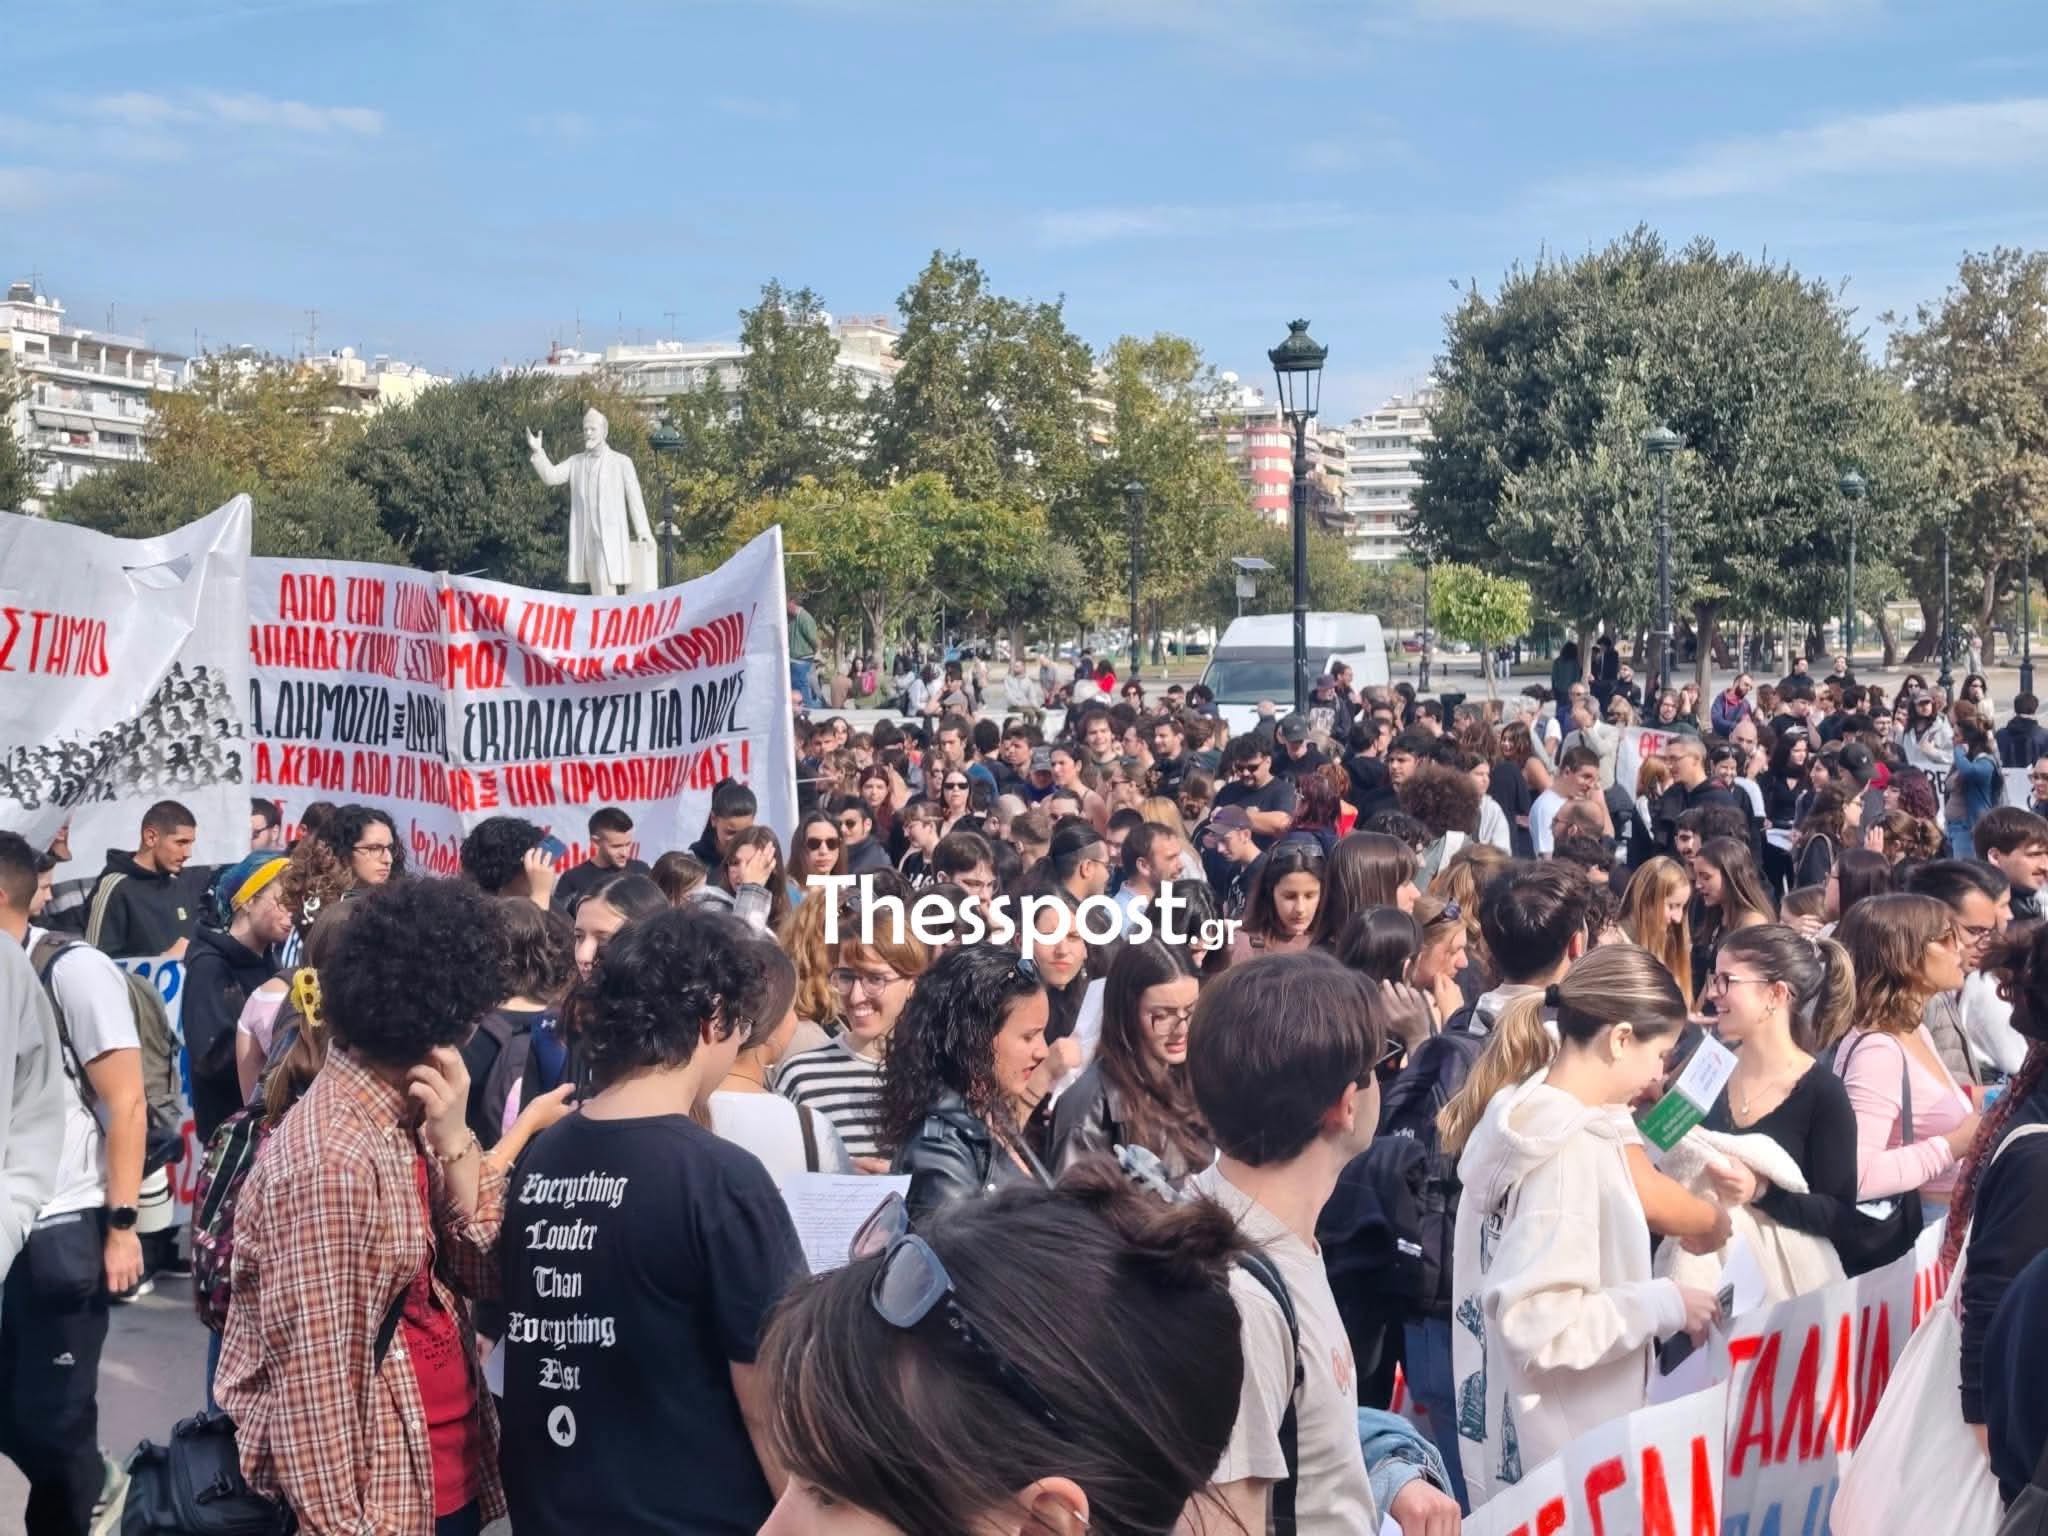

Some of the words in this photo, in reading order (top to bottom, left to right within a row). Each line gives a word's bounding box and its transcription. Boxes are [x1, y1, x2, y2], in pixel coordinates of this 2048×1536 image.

[280, 573, 335, 623] ΑΠΟ
[347, 576, 385, 627] ΤΗΝ
[437, 587, 510, 634] ΜΕΧΡΙ
[517, 601, 576, 650] ΤΗΝ
[590, 596, 682, 649] ΓΑΛΛΙΑ
[275, 680, 389, 746] ΔΗΜΟΣΙΑ
[463, 692, 641, 762] ΕΚΠΑΙΔΕΥΣΗ
[651, 688, 682, 750] ΓΙΑ
[278, 743, 344, 790] ΧΕΡΙΑ
[351, 750, 392, 797] ΑΠΟ
[396, 754, 416, 800] ΤΗ
[504, 762, 556, 807] ΤΗΝ
[519, 1170, 628, 1209] Everything
[525, 1218, 598, 1251] Louder
[533, 1266, 582, 1298] Than
[508, 1312, 616, 1350] Everything
